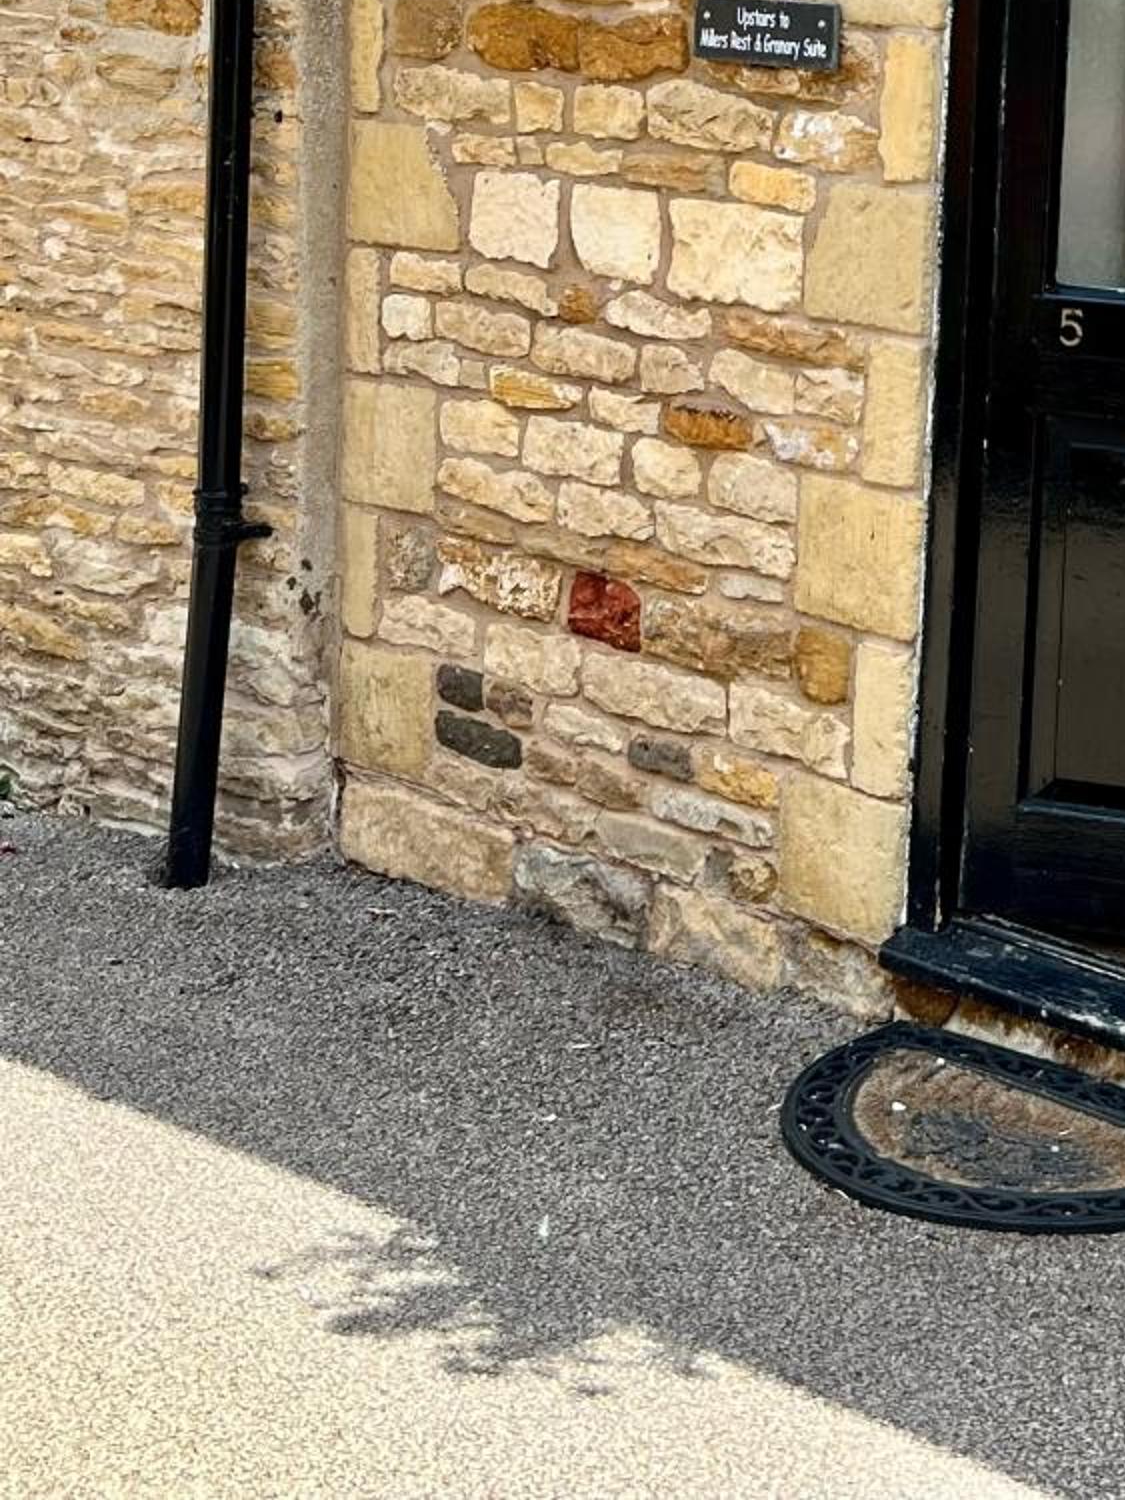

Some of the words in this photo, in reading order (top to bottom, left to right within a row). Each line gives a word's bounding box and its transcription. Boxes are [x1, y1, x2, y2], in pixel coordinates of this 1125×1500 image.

[737, 6, 777, 31] Upstairs
[779, 10, 790, 29] to
[730, 30, 752, 51] Rest
[763, 33, 801, 61] Granary
[803, 38, 827, 59] Suite
[1059, 308, 1084, 347] 5
